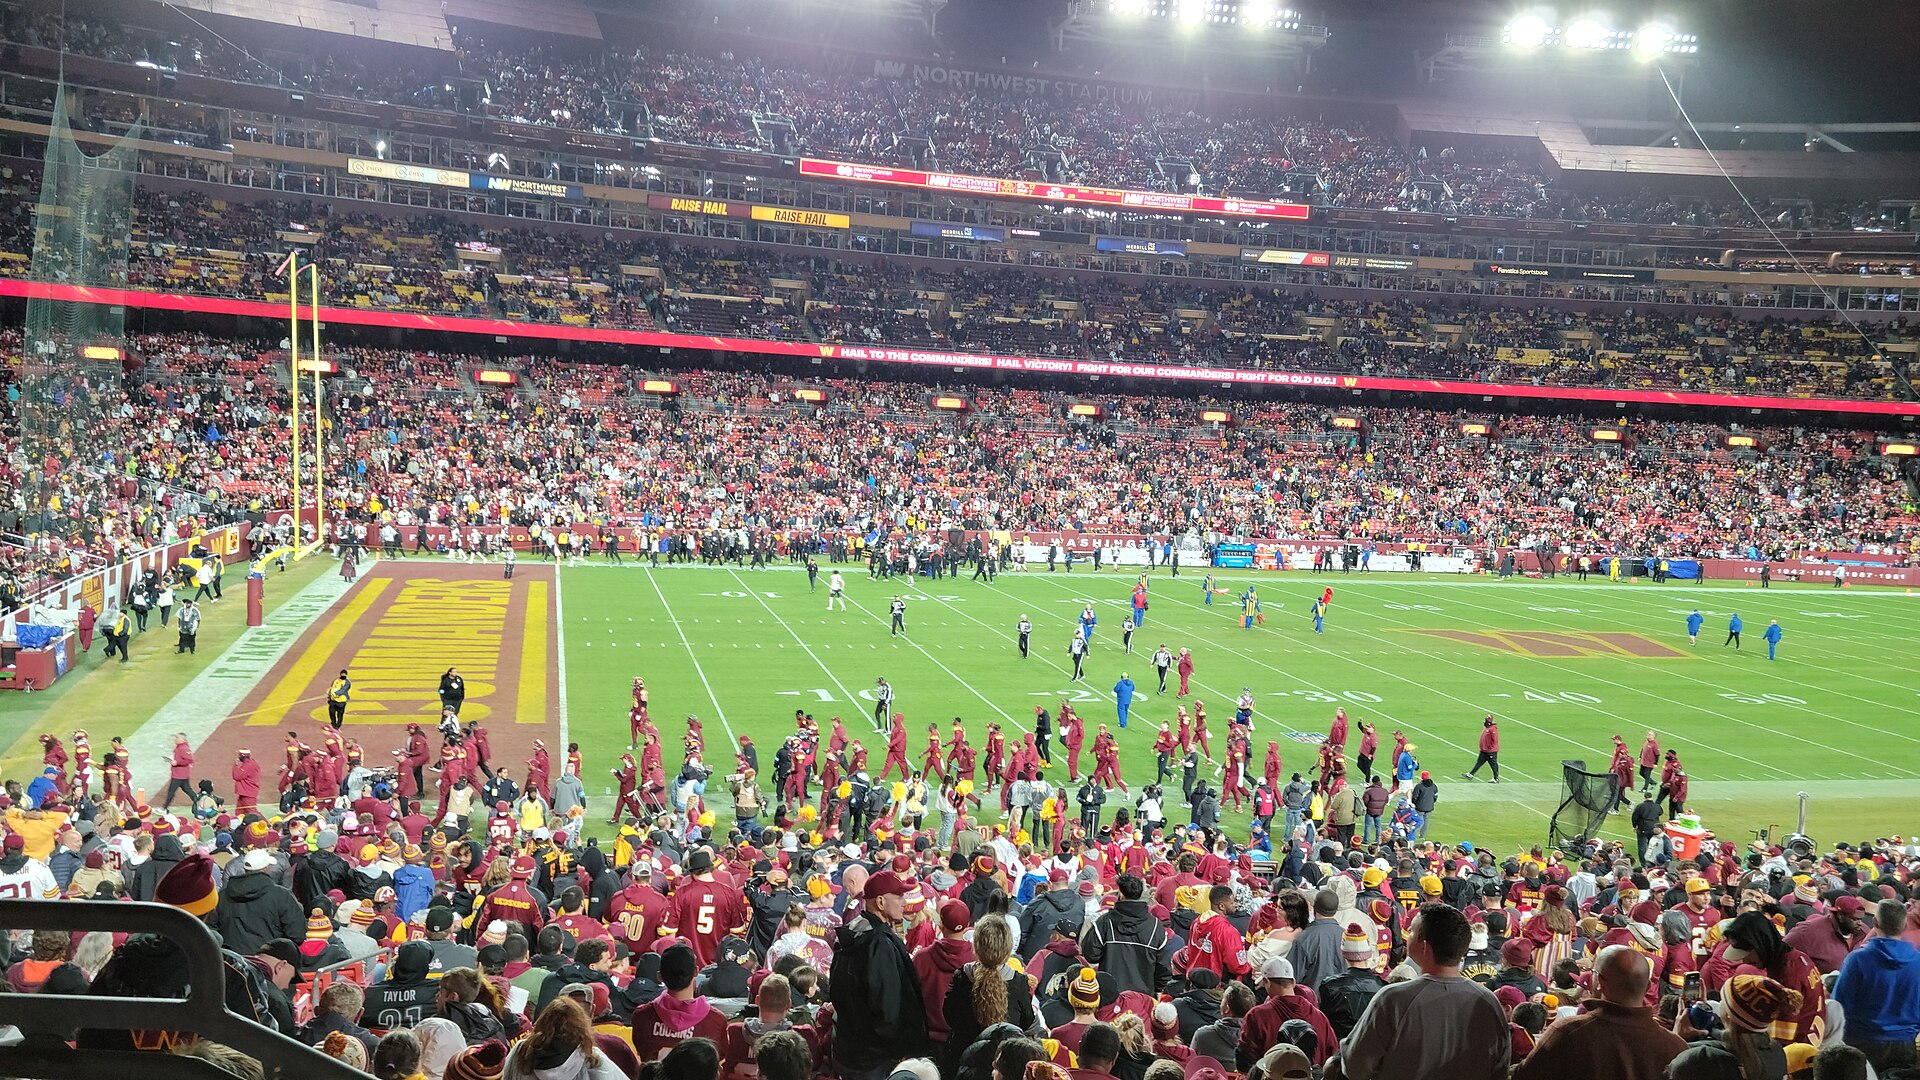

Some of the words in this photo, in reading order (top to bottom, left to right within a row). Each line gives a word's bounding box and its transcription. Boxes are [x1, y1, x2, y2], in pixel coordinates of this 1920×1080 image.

[913, 64, 1049, 97] NORTHWEST
[1054, 81, 1153, 105] STADIUM
[512, 179, 567, 193] NORTHWEST
[950, 177, 998, 189] NORTHWEST
[1144, 194, 1191, 205] NORTHWEST
[671, 198, 701, 213] RAISE
[703, 201, 728, 216] HAIL
[774, 210, 802, 223] RAISE
[804, 213, 827, 226] HAIL
[1498, 267, 1519, 275] Fanatics
[1519, 268, 1548, 276] Sportsbook
[840, 348, 867, 359] HAIL
[869, 350, 885, 360] TO
[886, 351, 909, 361] THE
[910, 352, 992, 366] COMMANDERS!
[997, 359, 1022, 368] HAIL
[1024, 360, 1073, 371] VICTORY!
[1077, 364, 1108, 374] FIGHT
[1110, 366, 1132, 375] FOR
[1133, 367, 1155, 376] OUR
[1156, 368, 1234, 380] COMMANDERS!
[1236, 372, 1267, 382] FIGHT
[1268, 374, 1290, 383] FOR
[1290, 375, 1312, 384] OLD
[226, 630, 294, 663] TAKES
[310, 577, 514, 724] COMMANDERS
[208, 668, 259, 679] IT
[1293, 690, 1383, 703] 30
[1522, 690, 1602, 704] 40
[1717, 692, 1807, 704] 50
[1671, 836, 1685, 852] G
[494, 897, 531, 909] REDSKINS
[697, 906, 715, 934] 5
[384, 989, 416, 1003] TAYLOR
[653, 1021, 695, 1040] COUSINS
